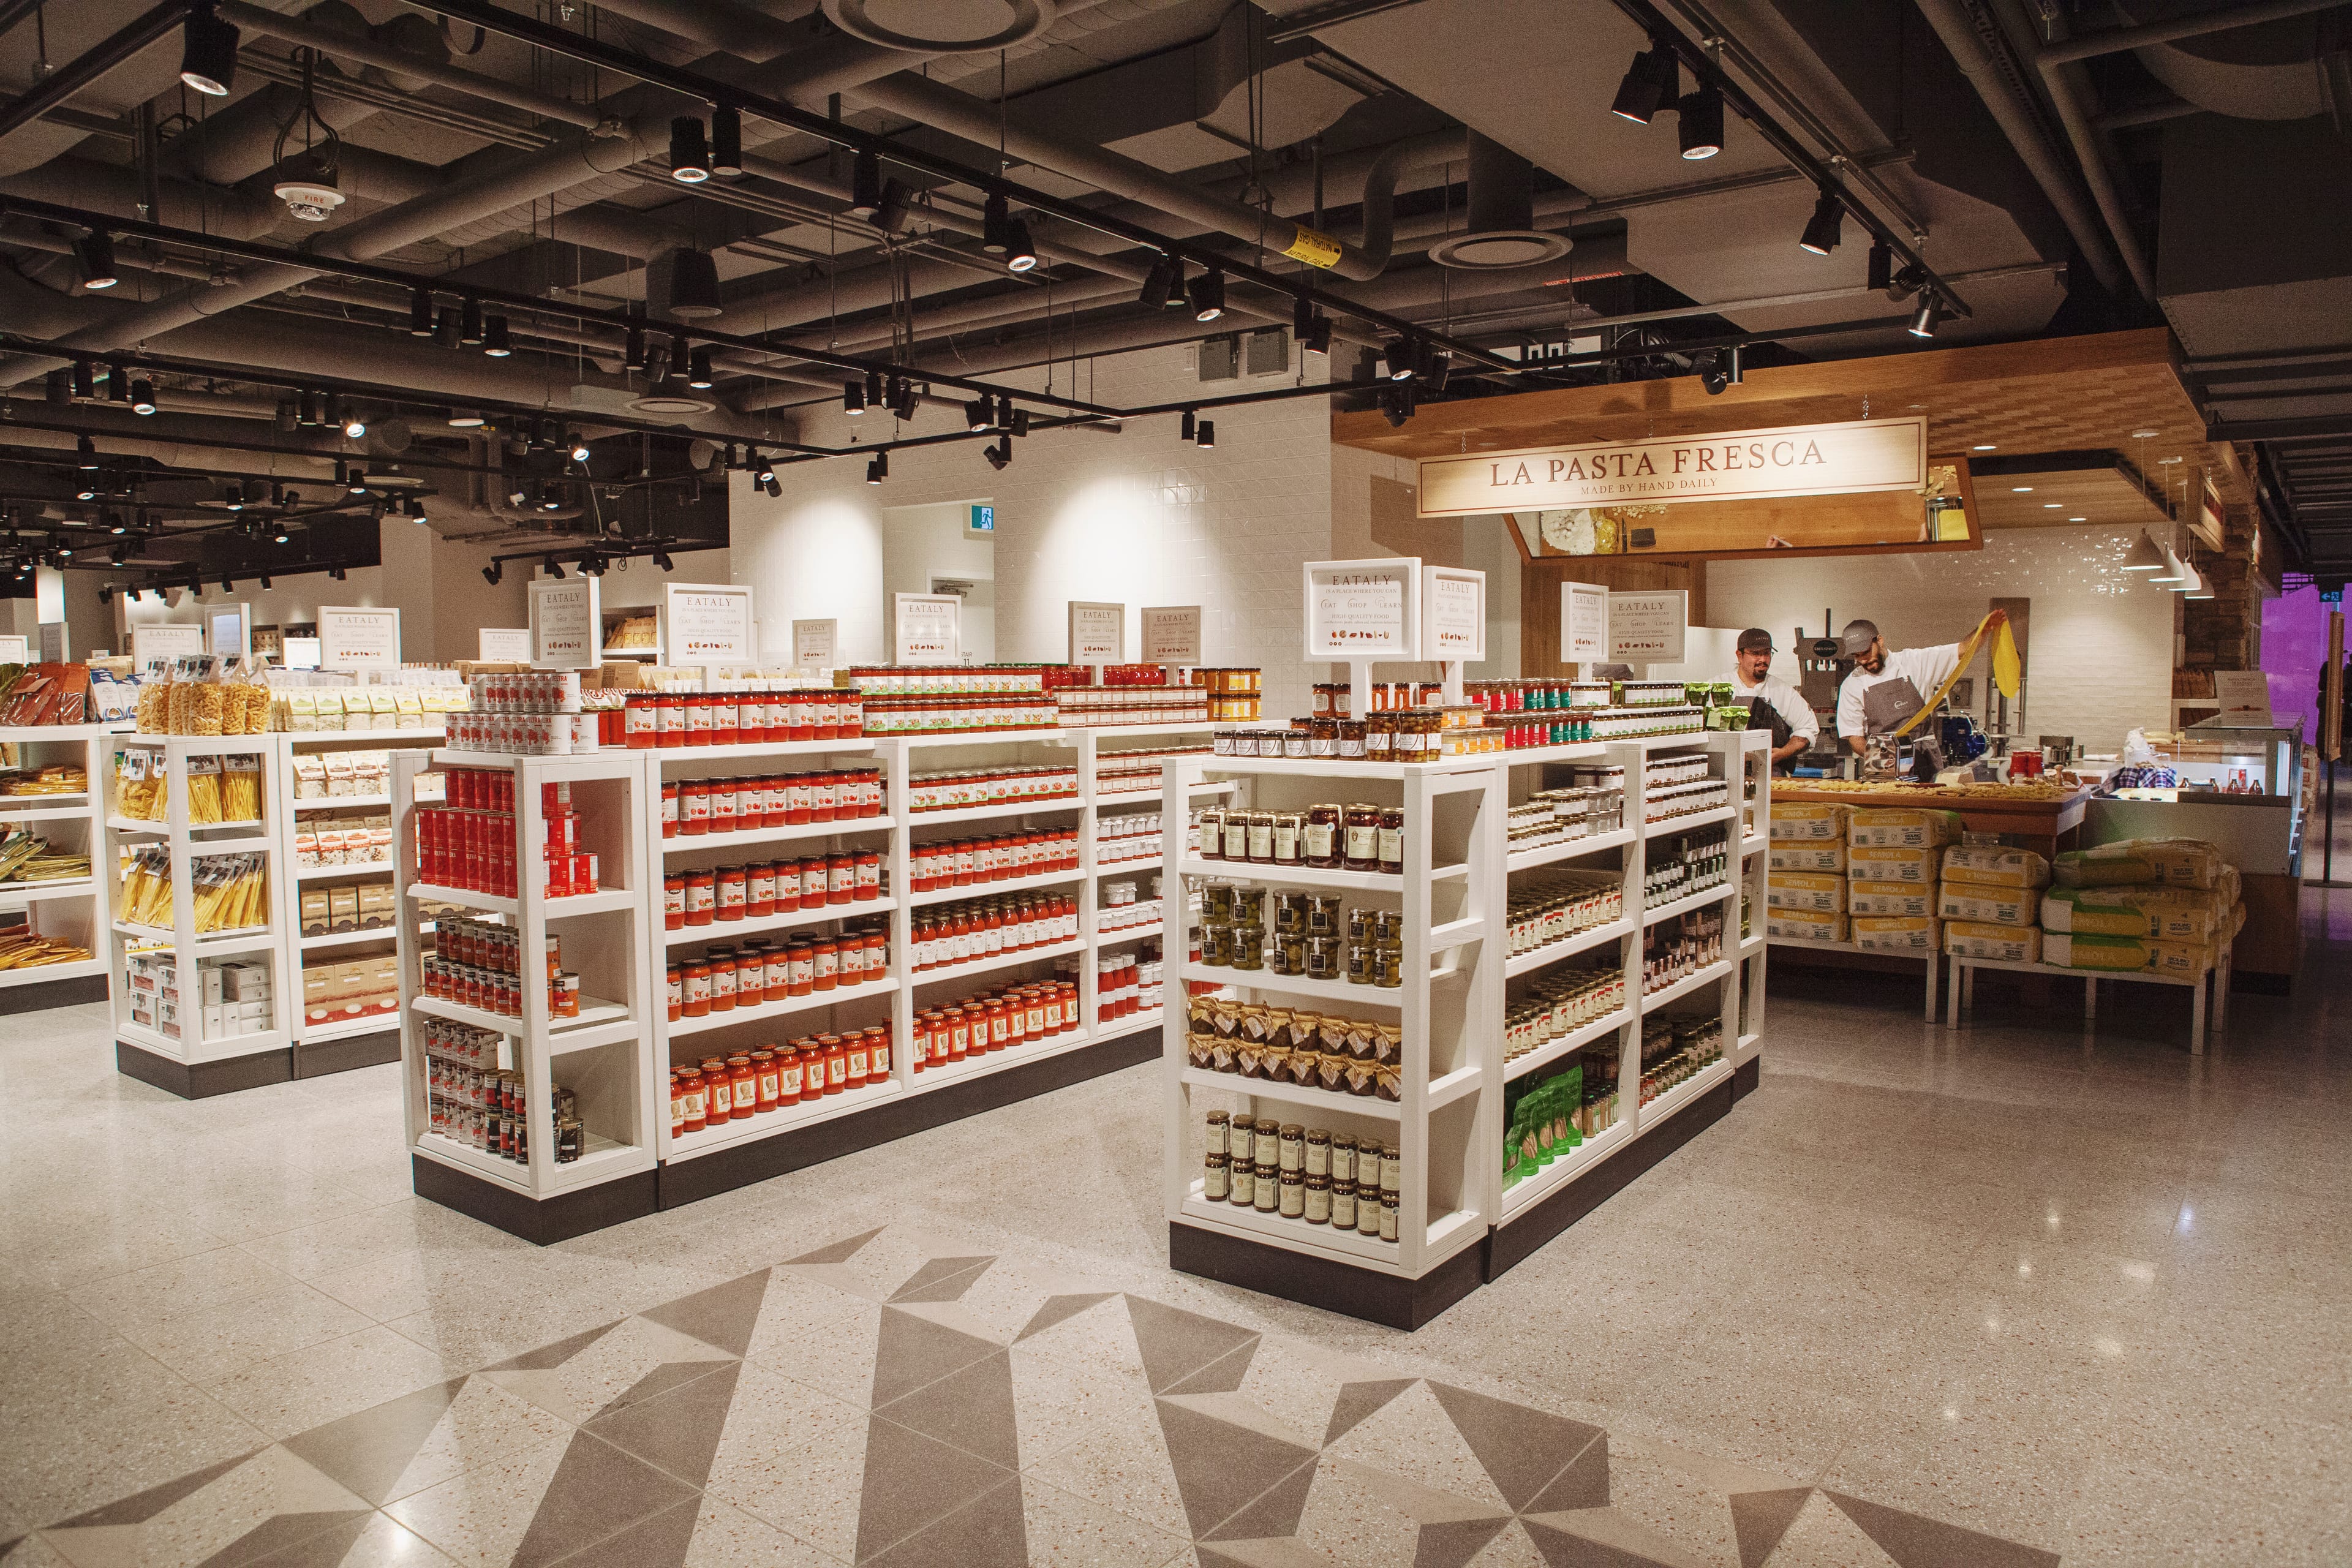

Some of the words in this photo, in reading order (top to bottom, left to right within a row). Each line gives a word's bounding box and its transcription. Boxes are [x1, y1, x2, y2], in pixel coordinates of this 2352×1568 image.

[1299, 233, 1310, 244] GAS
[1311, 237, 1333, 254] NATURAL
[1490, 461, 1534, 486] LA
[1547, 452, 1658, 482] PASTA
[1672, 439, 1827, 473] FRESCA
[1581, 484, 1614, 495] MADE
[1619, 483, 1634, 492] BY
[1638, 481, 1675, 491] HAND
[1680, 478, 1717, 489] DAILY
[1333, 575, 1392, 586] EATALY
[1441, 581, 1470, 594] EATALY
[547, 592, 581, 603] EATALY
[687, 597, 732, 606] EATALY
[1575, 595, 1597, 605] EATALY
[1618, 602, 1665, 611] EATALY
[1156, 614, 1189, 622] EATALY
